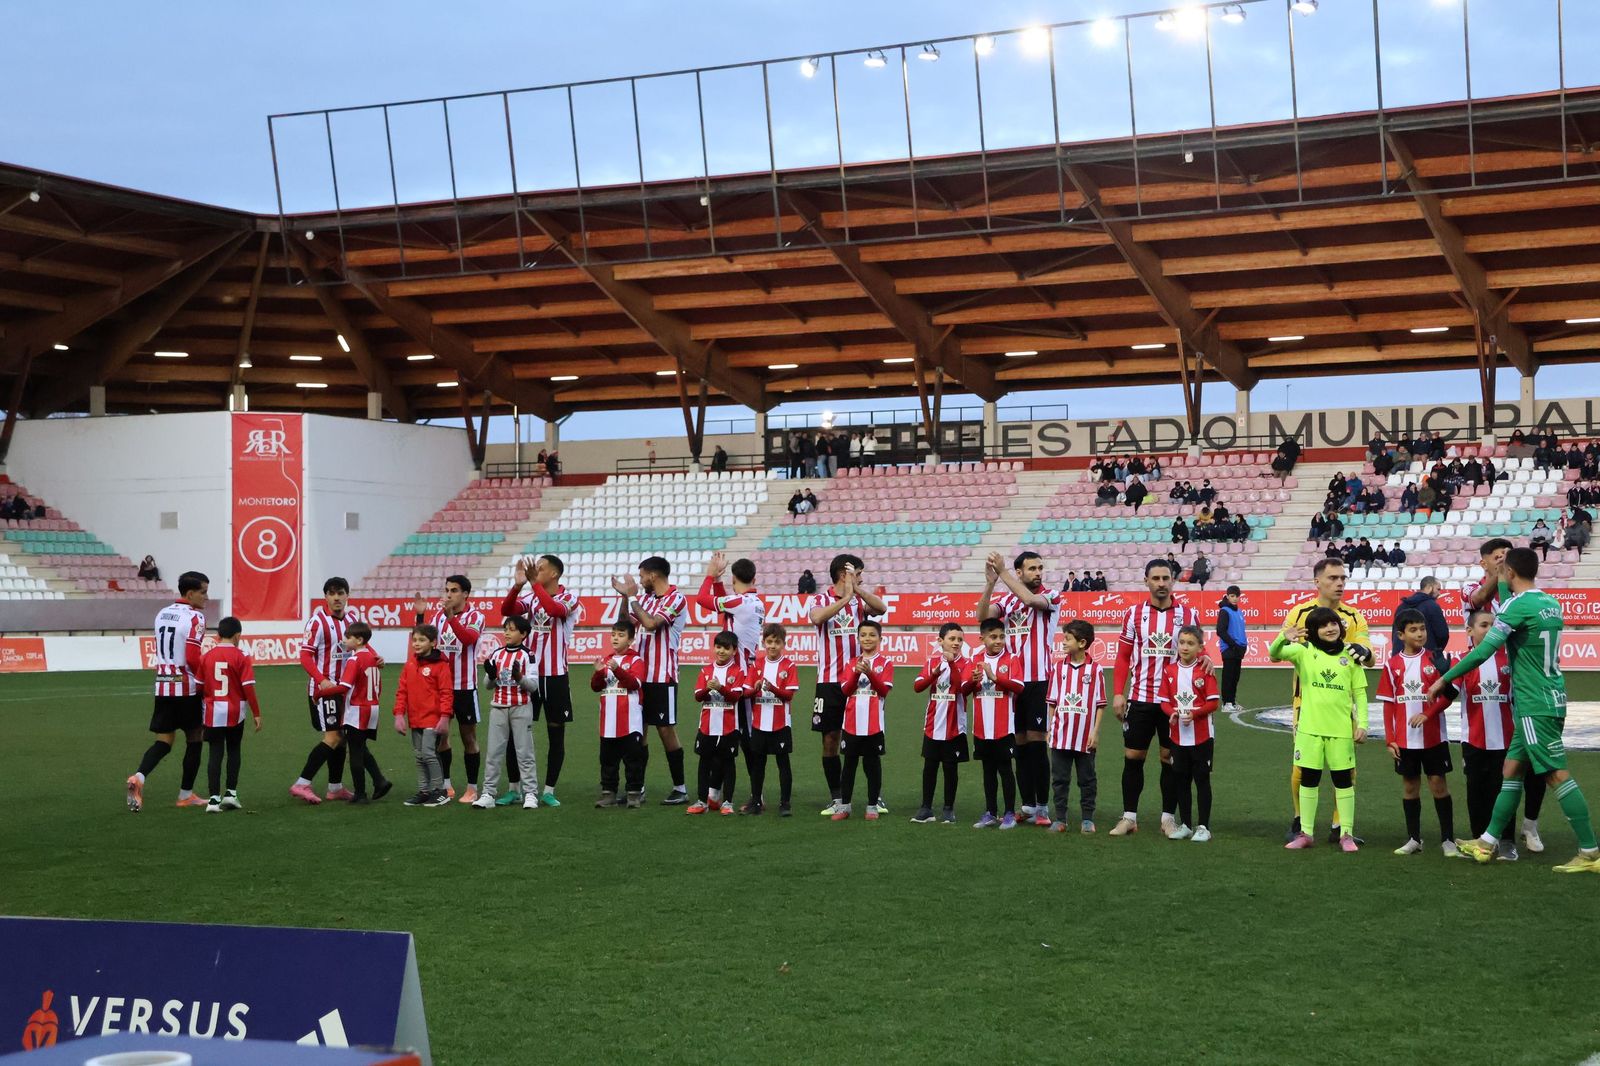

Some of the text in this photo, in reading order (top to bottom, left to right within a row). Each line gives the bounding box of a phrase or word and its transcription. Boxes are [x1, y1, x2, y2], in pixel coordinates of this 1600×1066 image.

[1002, 400, 1600, 458] ESTADO MUNICIPAL
[238, 497, 297, 506] MONTETORO
[257, 529, 278, 560] 8
[912, 609, 960, 620] sangregorio
[1082, 608, 1128, 620] sangregori
[159, 626, 176, 660] 17
[784, 635, 817, 651] CAMI
[880, 635, 918, 652] PLATA
[1558, 644, 1597, 658] OVA
[214, 662, 228, 696] 5
[1312, 681, 1344, 691] CAJA RURAL
[324, 700, 336, 714] 19
[814, 698, 824, 713] 20
[70, 994, 250, 1041] VERSUS
